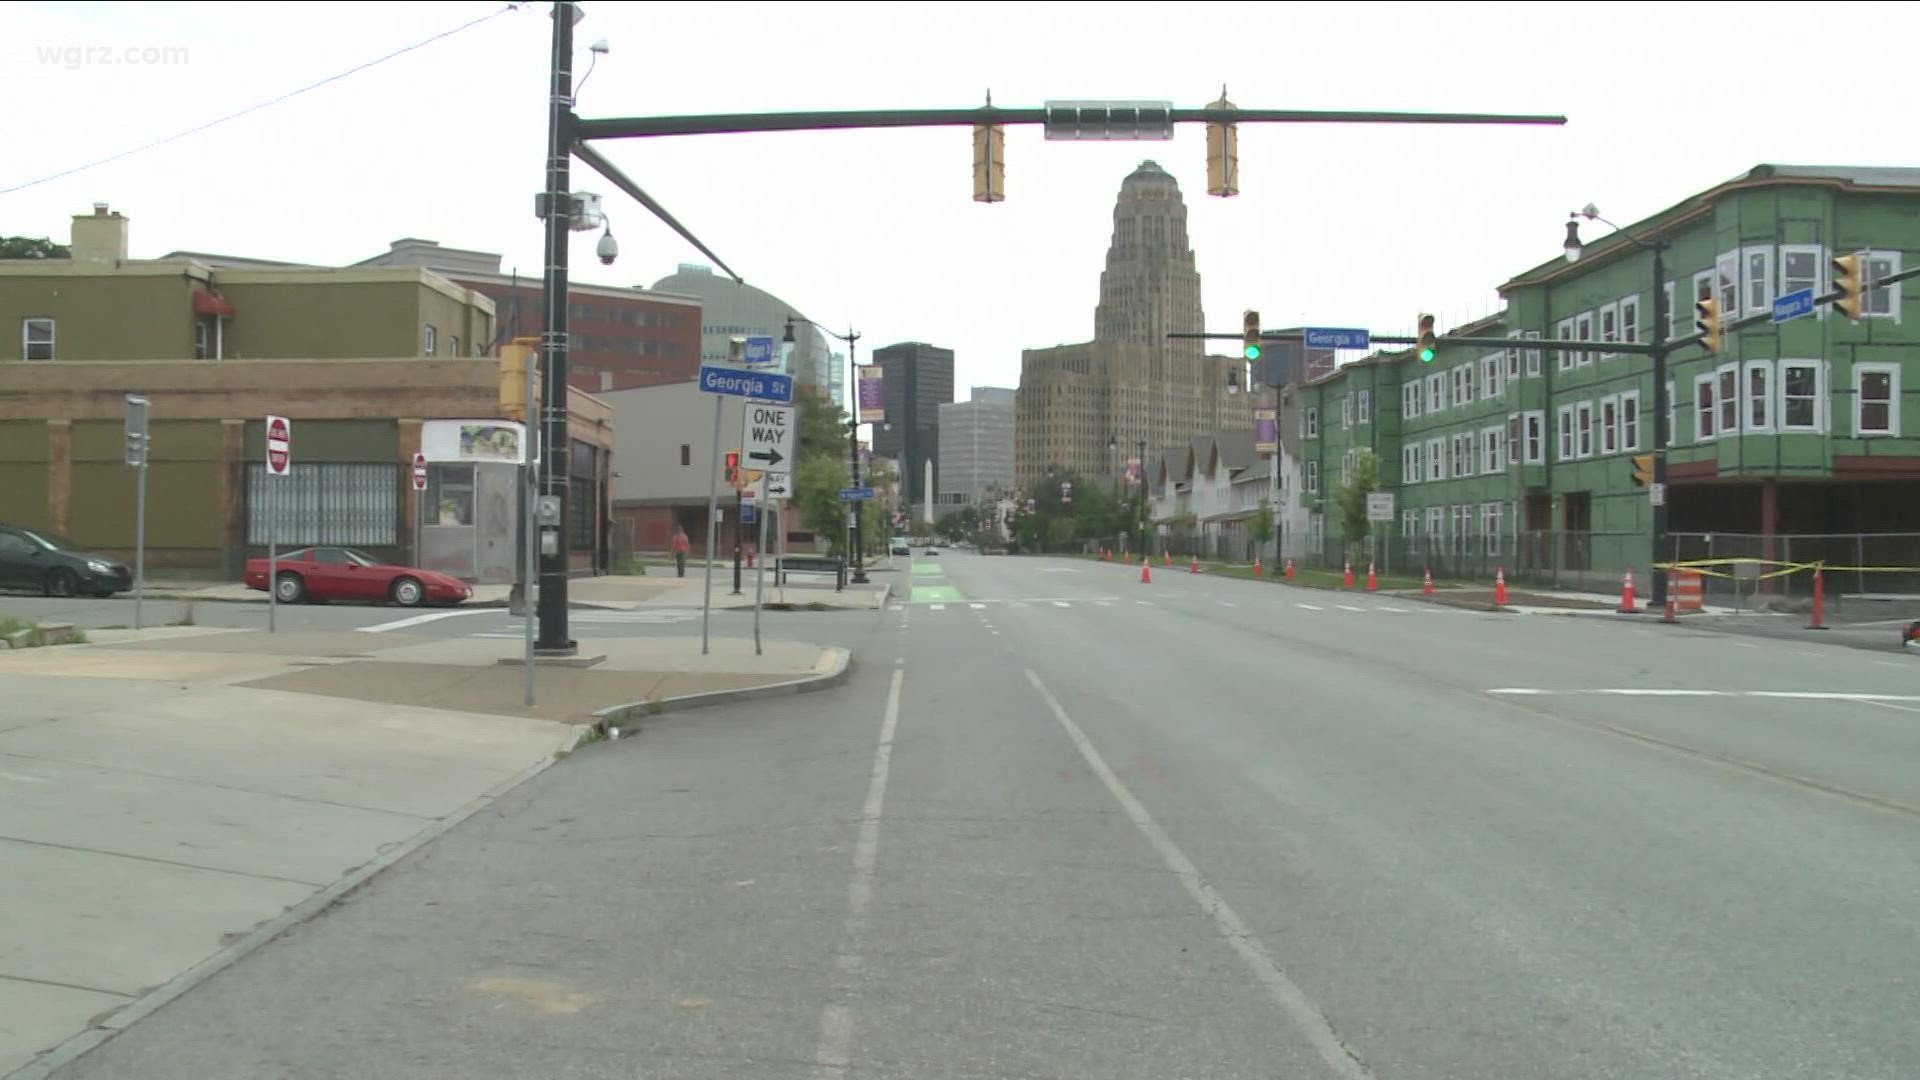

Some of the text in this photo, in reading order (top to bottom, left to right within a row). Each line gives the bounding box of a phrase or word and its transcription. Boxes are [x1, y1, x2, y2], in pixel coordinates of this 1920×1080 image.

[1309, 331, 1350, 349] Georgia
[706, 372, 785, 395] Georgia St
[754, 409, 785, 426] ONE
[752, 427, 785, 443] WAY
